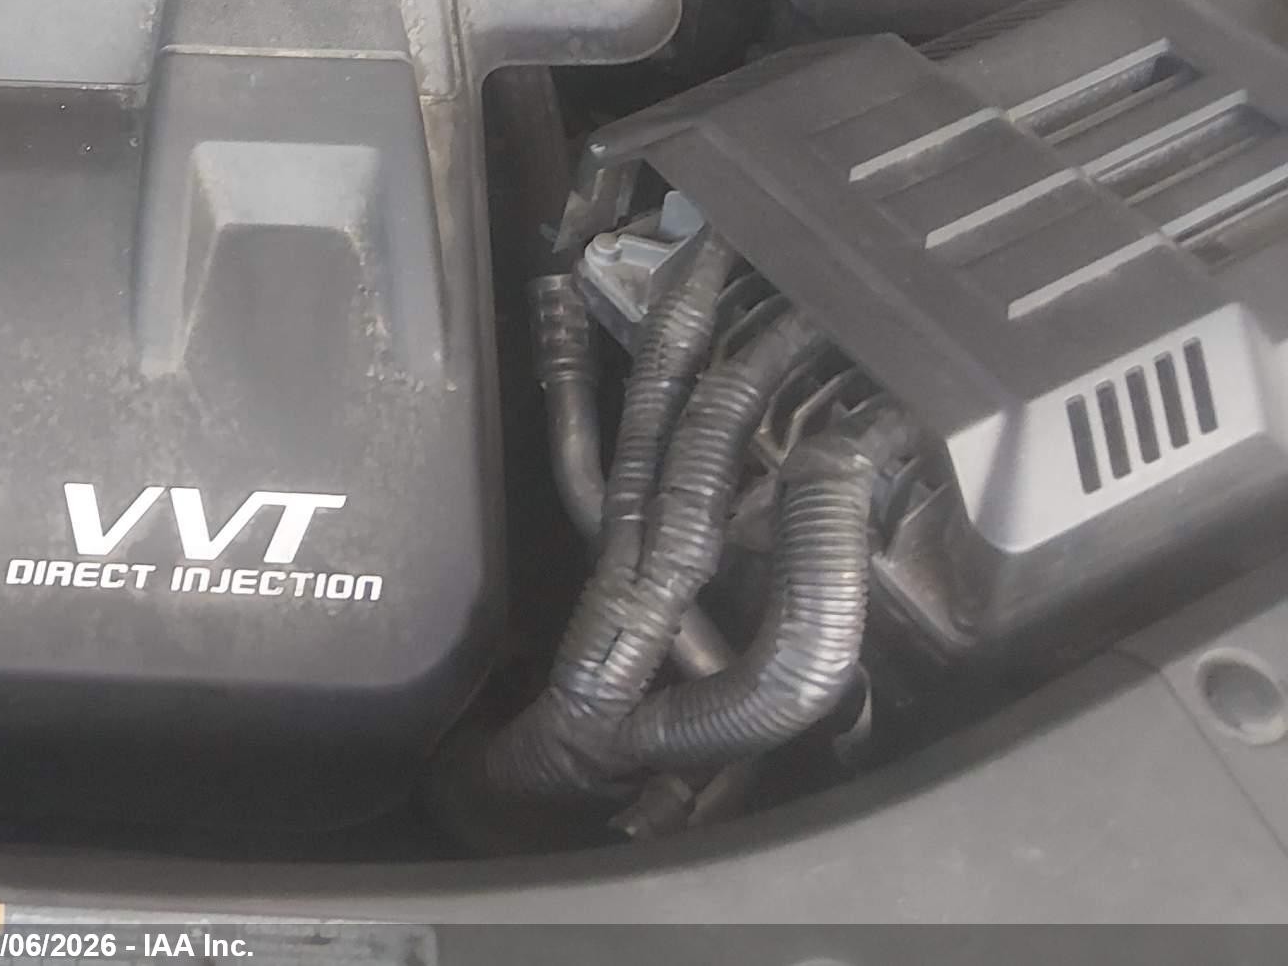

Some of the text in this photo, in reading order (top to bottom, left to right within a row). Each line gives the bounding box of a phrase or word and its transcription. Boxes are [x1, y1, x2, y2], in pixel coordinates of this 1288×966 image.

[64, 483, 347, 564] VVT
[6, 559, 383, 600] DIRECT INJECTION
